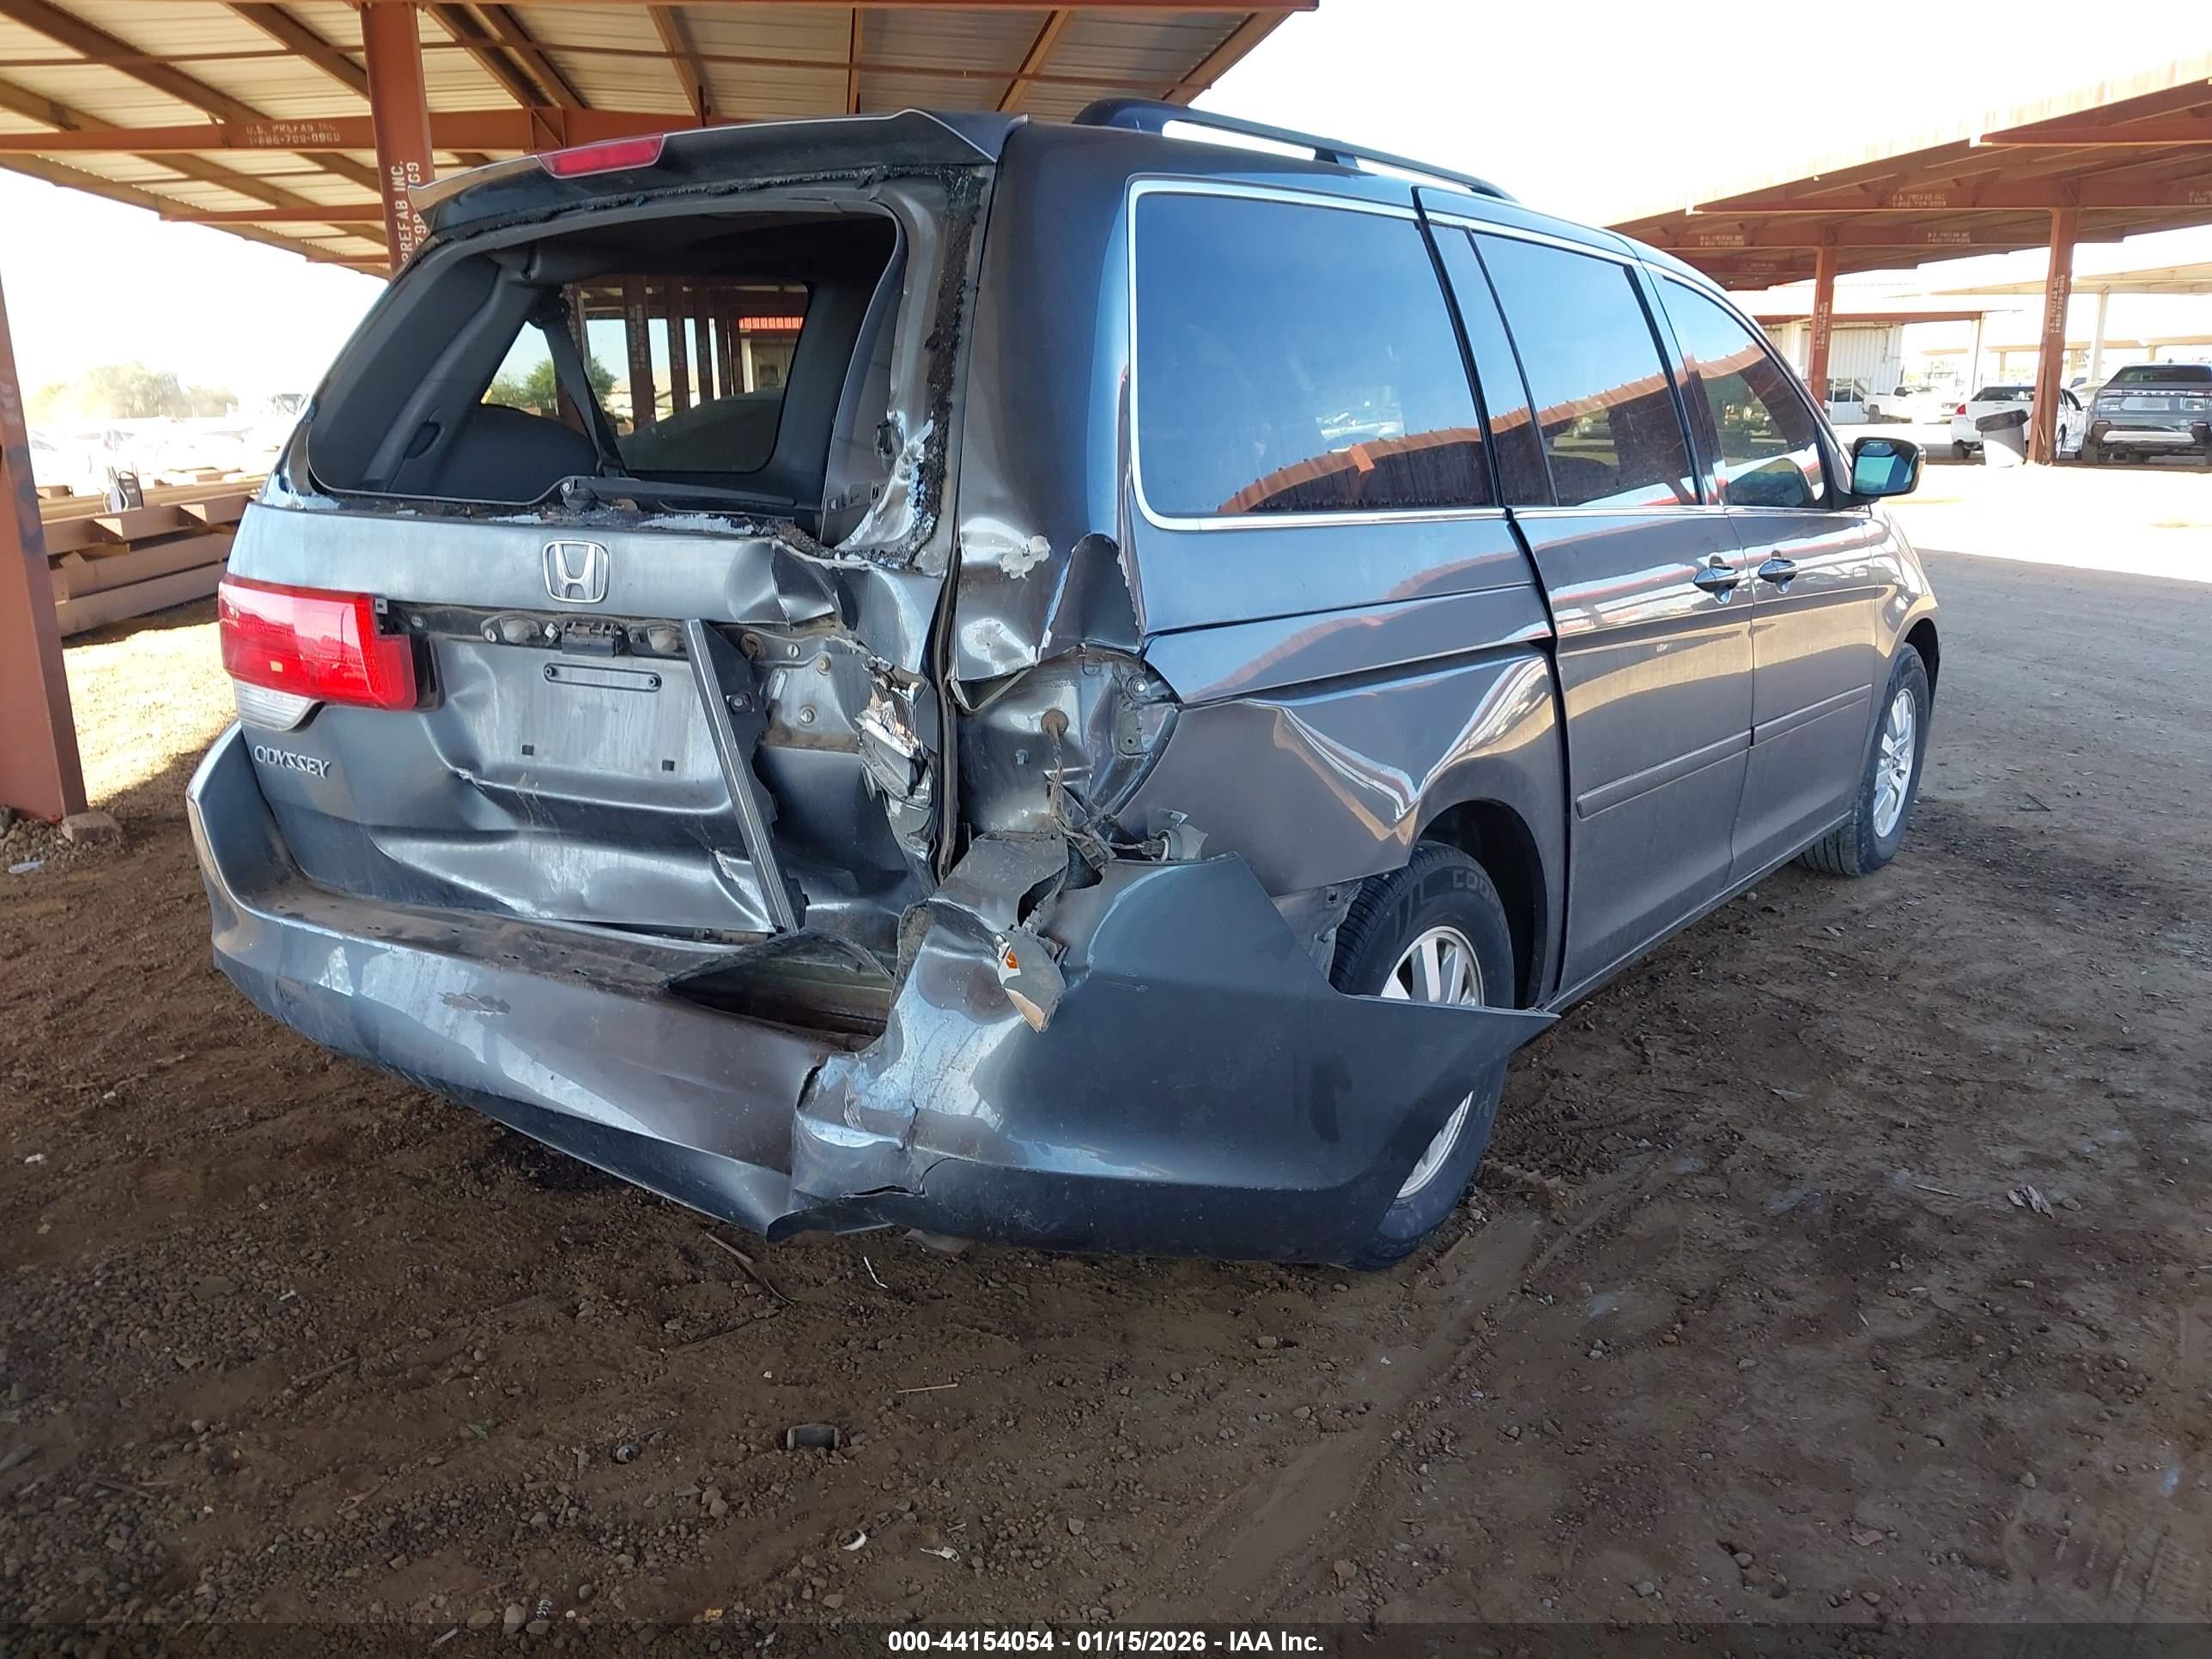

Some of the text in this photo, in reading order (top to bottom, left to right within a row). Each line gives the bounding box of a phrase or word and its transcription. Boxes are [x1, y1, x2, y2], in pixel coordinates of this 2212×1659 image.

[390, 160, 413, 262] PREFAB INC.
[254, 744, 331, 777] ODYSSEY
